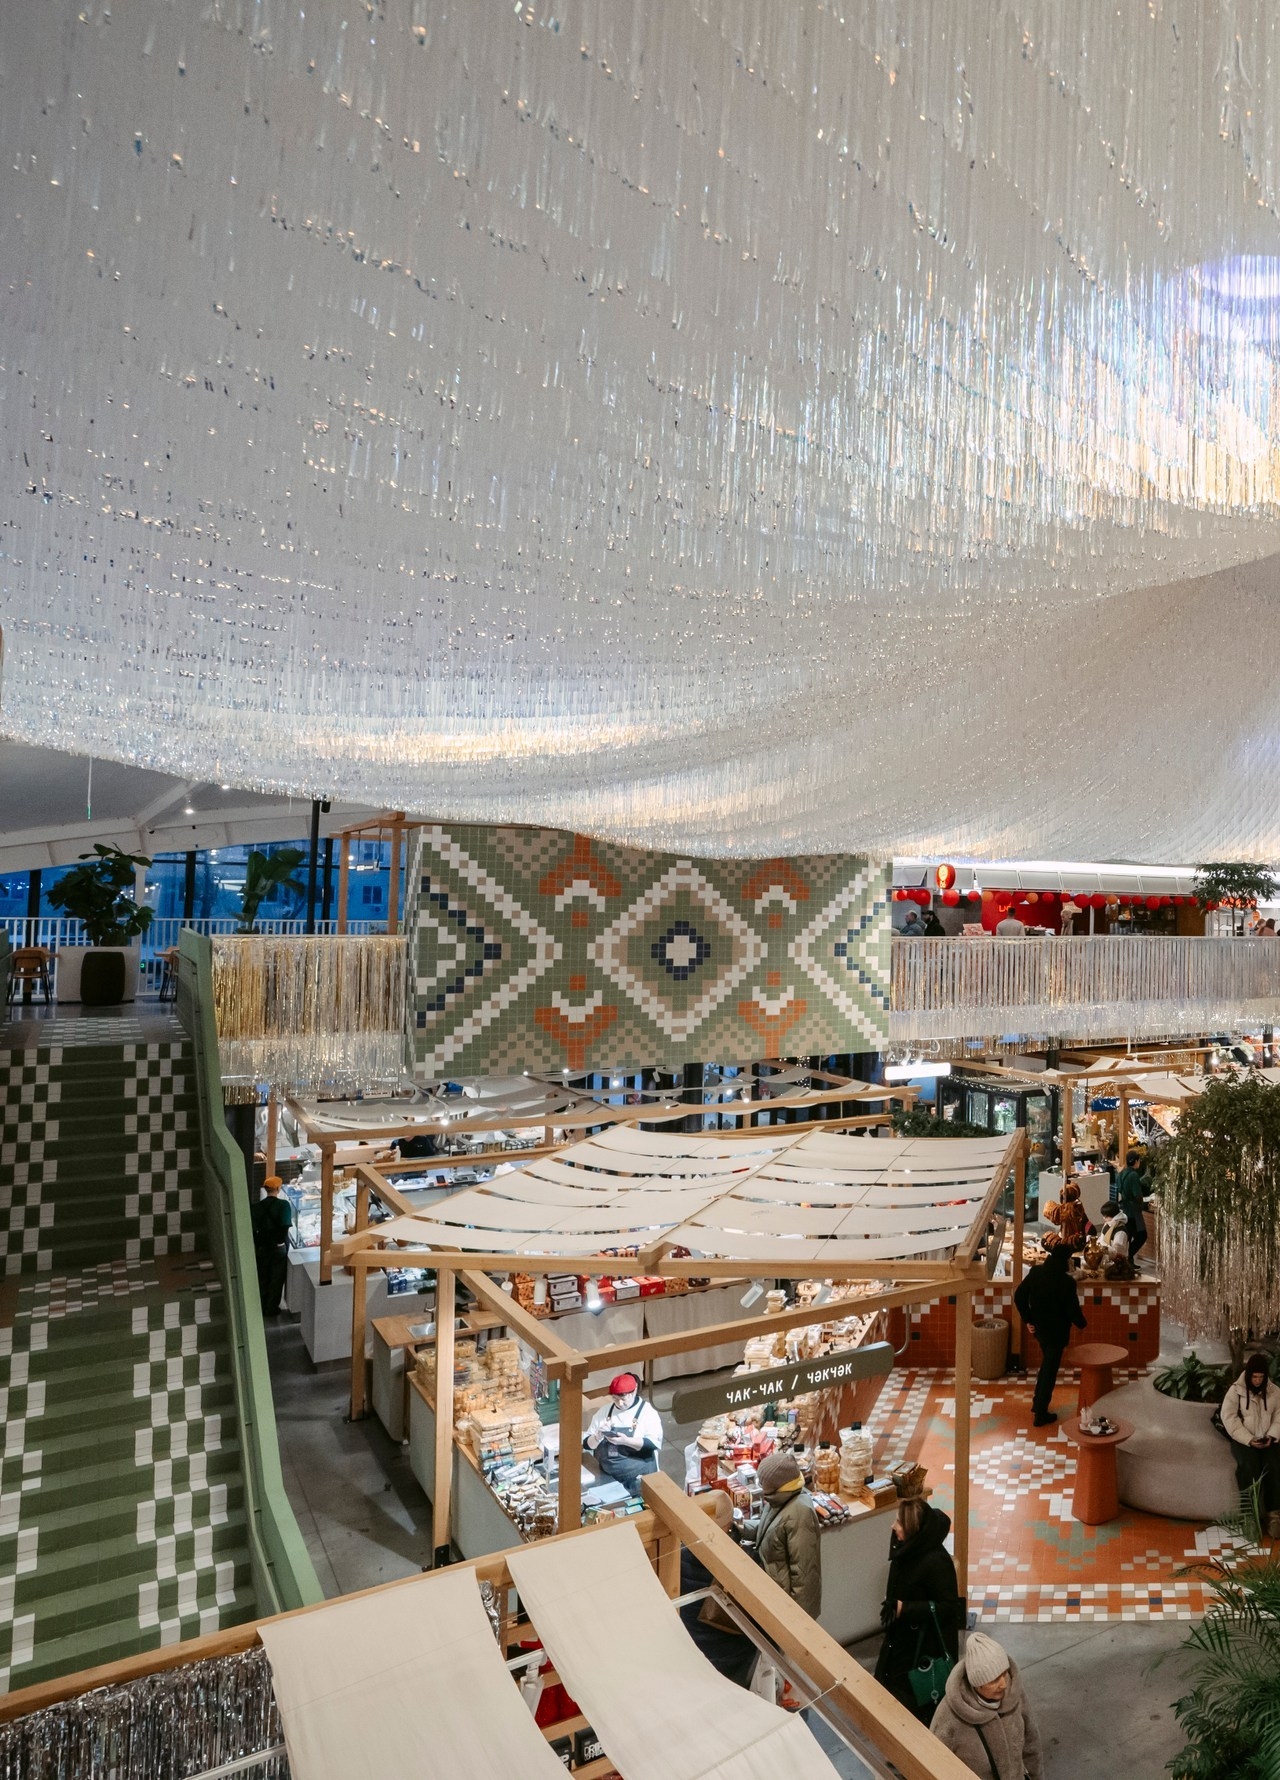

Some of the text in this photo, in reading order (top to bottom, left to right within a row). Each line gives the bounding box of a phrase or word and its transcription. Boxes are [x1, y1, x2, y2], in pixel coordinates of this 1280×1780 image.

[726, 1362, 853, 1404] ЧАК-ЧАК / ЧӘКЧӘК
